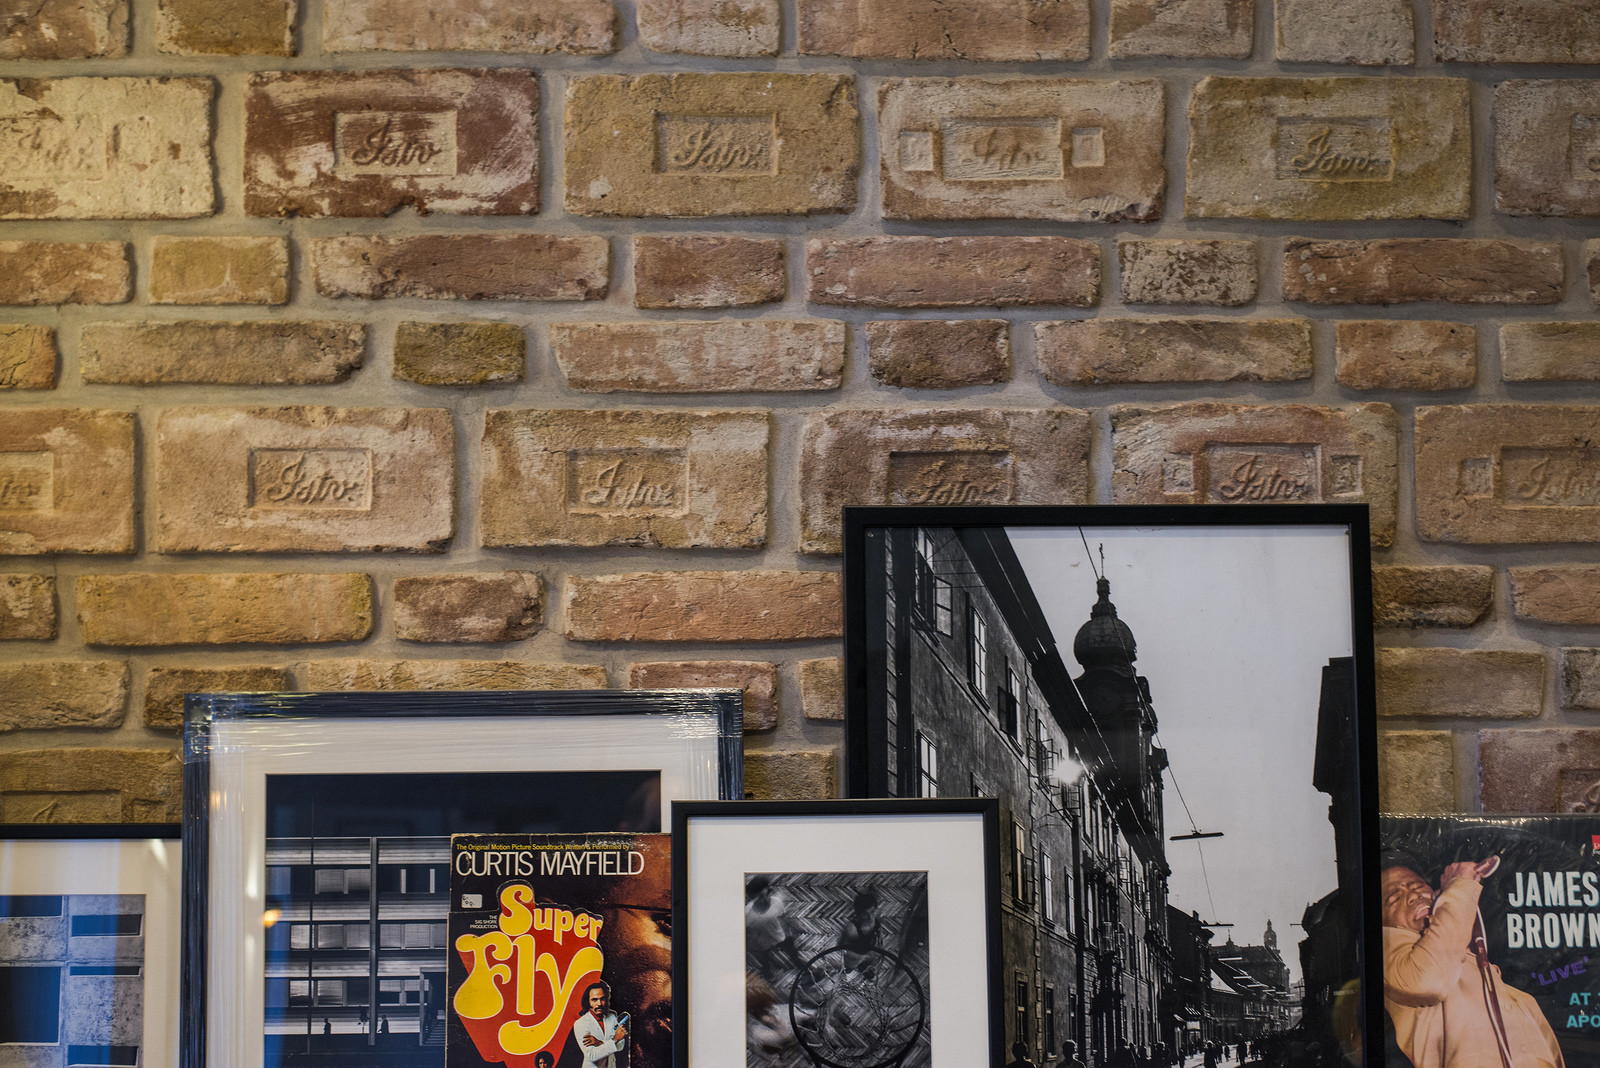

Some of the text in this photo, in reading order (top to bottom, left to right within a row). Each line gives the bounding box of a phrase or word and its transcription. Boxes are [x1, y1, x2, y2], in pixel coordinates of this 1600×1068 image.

[456, 851, 645, 876] CURTIS MAYFIELD
[1508, 871, 1600, 908] JAMES
[499, 884, 604, 946] Super
[453, 931, 604, 1055] Fly
[1569, 992, 1591, 1006] AT
